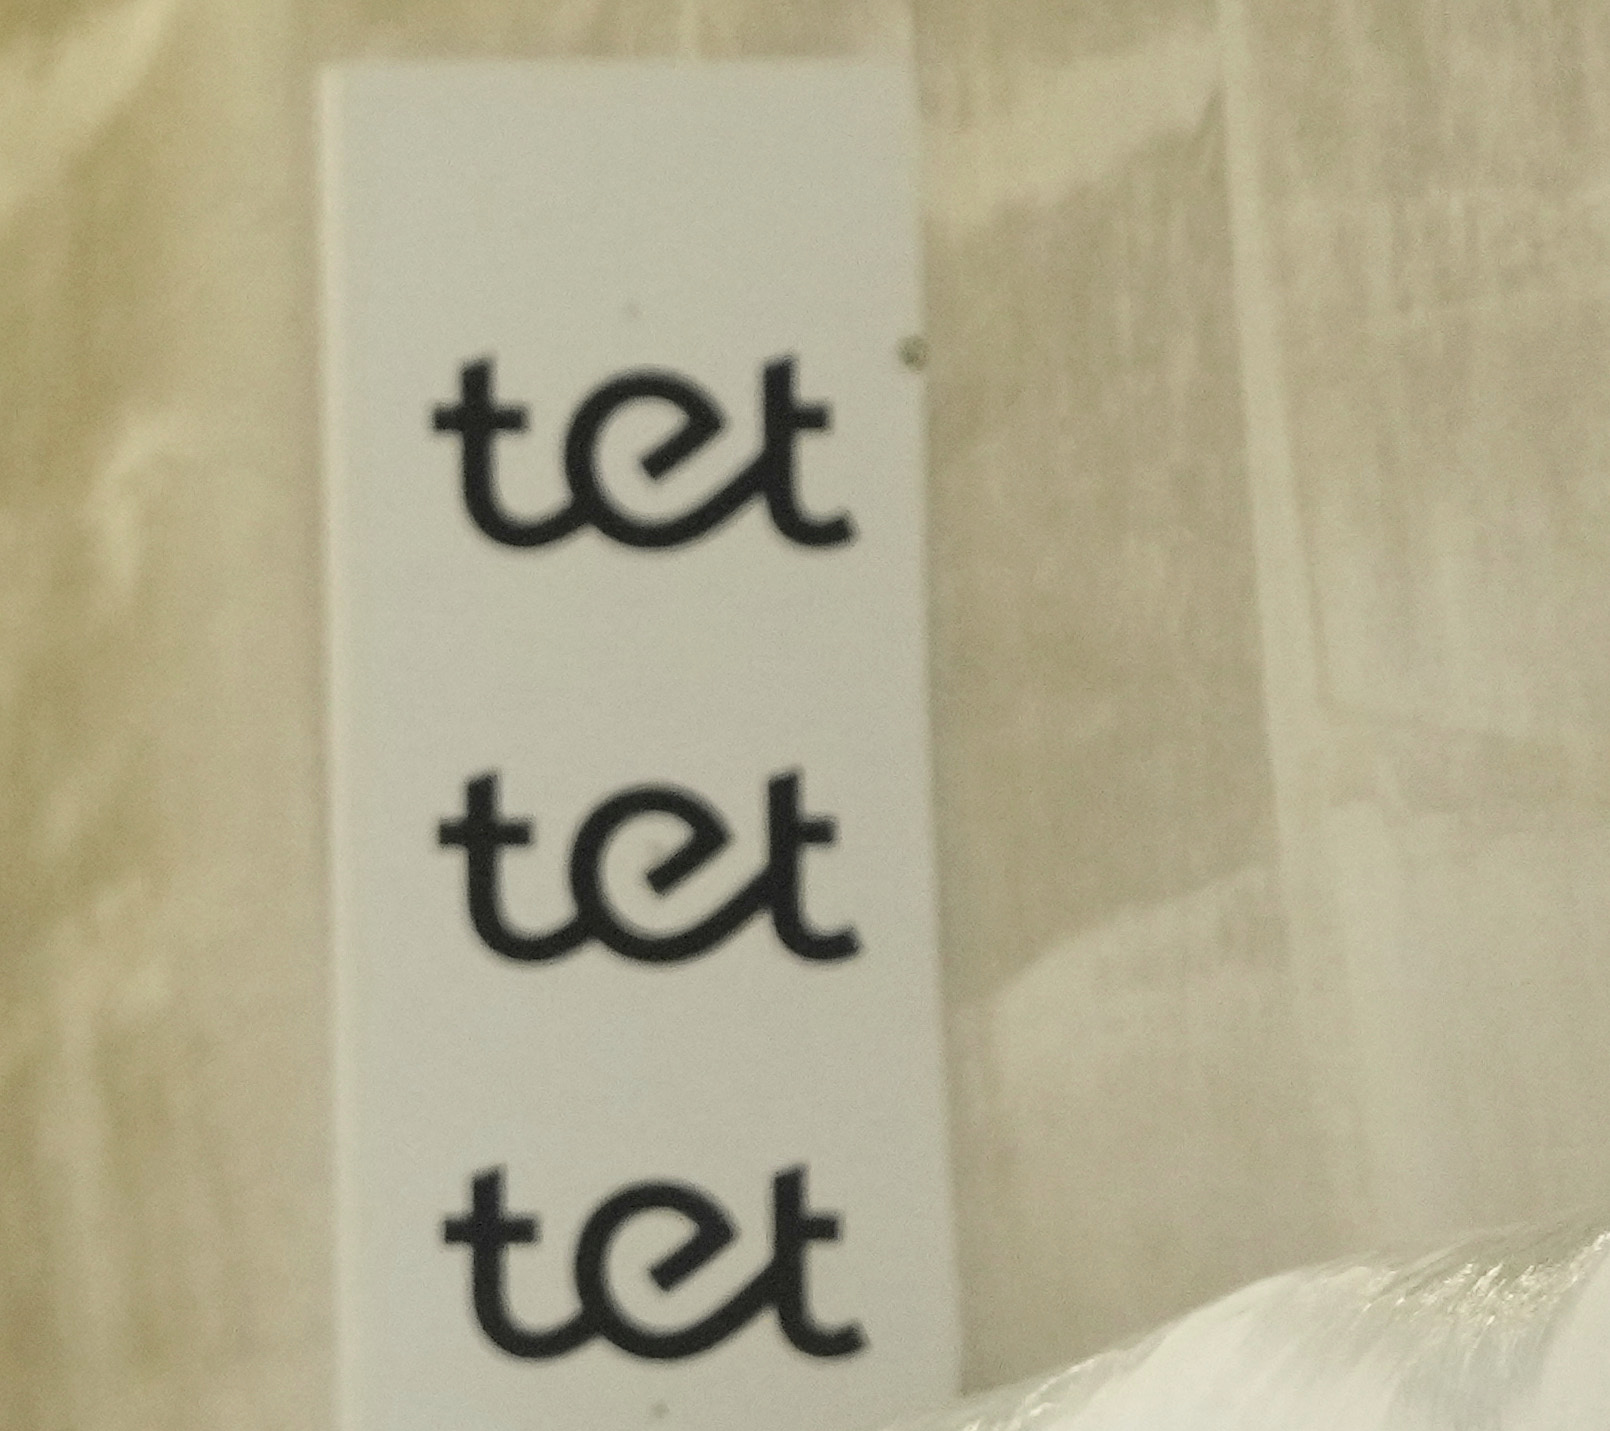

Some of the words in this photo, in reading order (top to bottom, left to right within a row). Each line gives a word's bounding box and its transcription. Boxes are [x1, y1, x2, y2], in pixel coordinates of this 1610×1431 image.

[431, 356, 859, 549] tet
[436, 771, 865, 964] tet
[442, 1164, 872, 1360] tet
